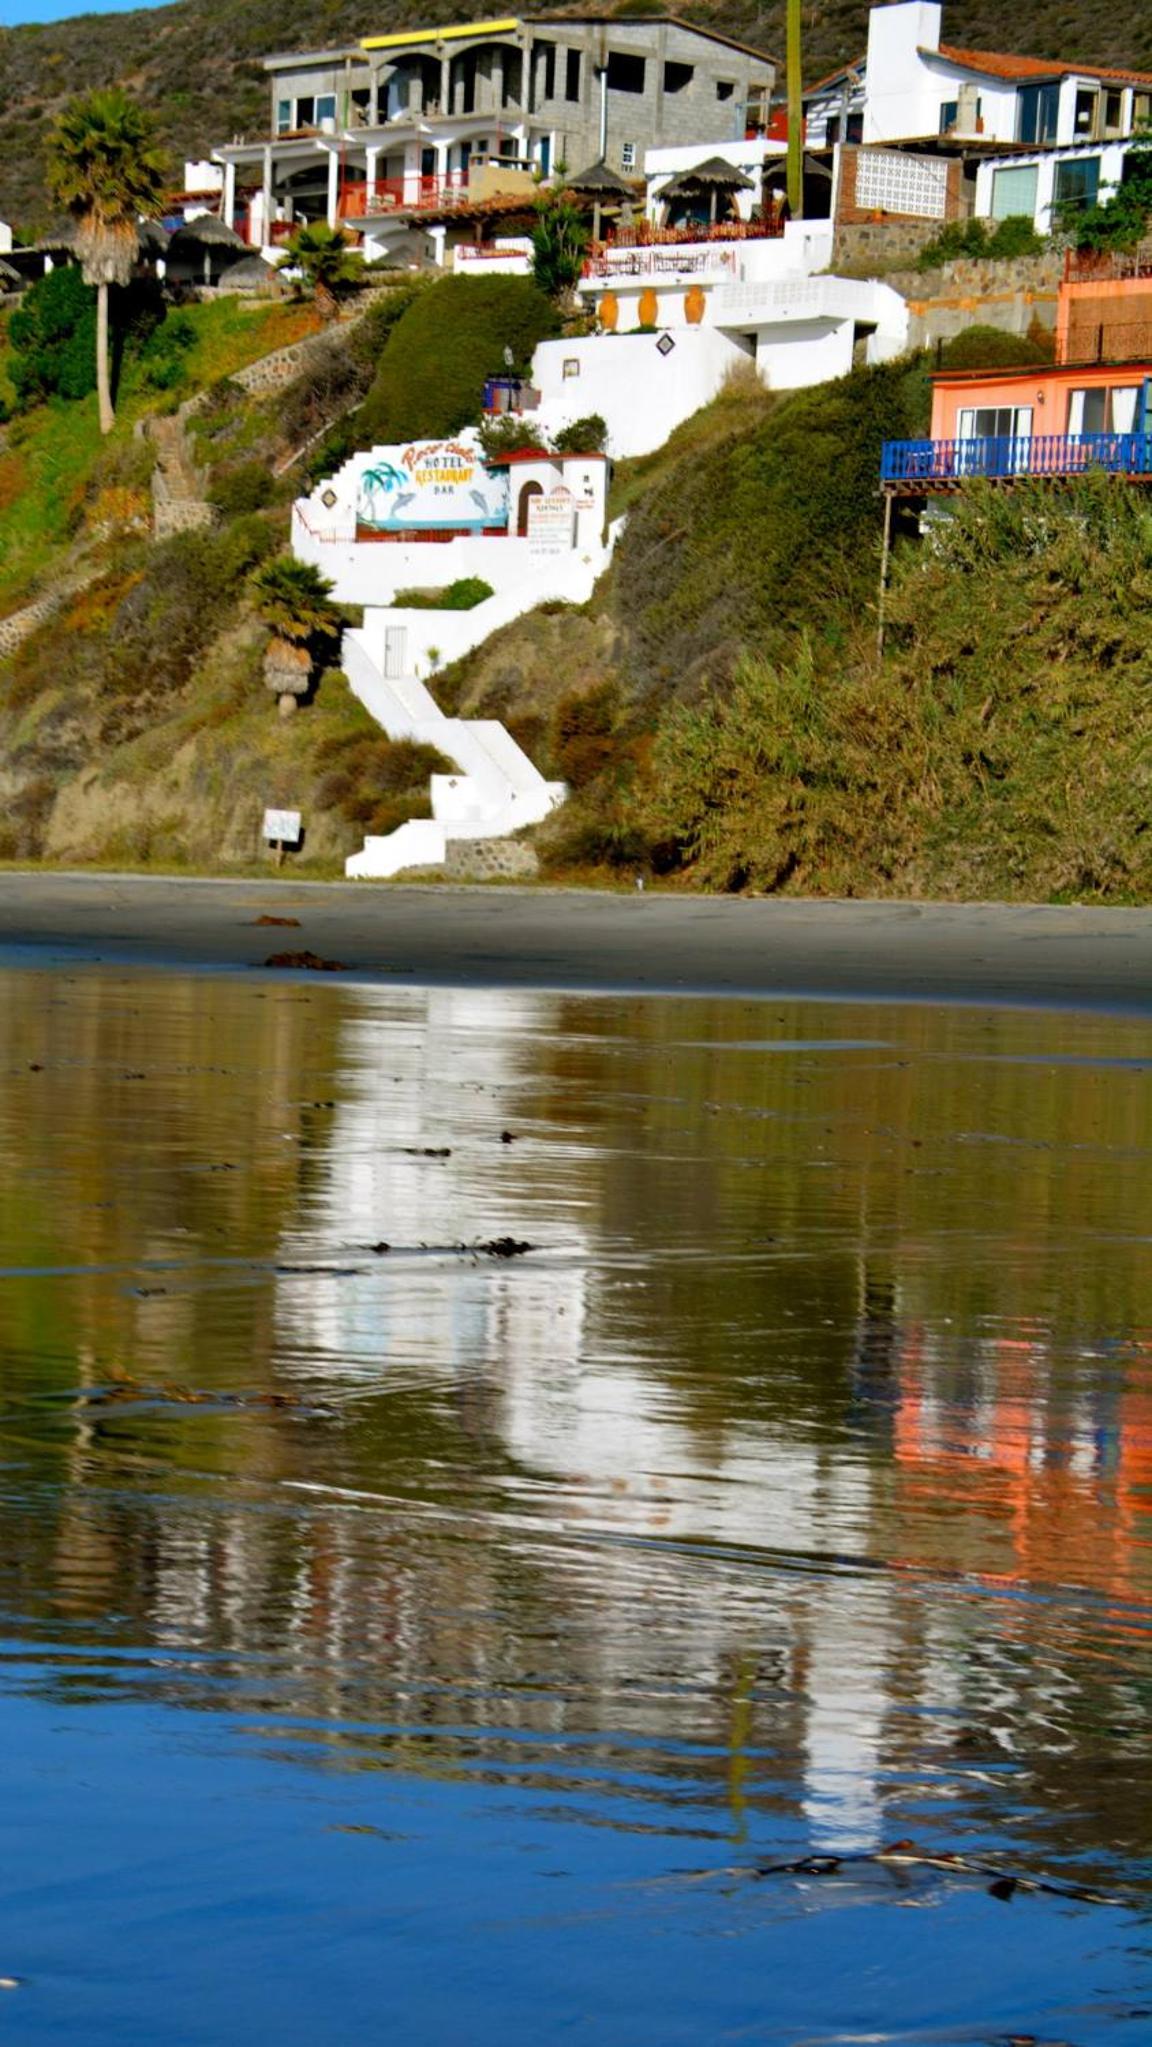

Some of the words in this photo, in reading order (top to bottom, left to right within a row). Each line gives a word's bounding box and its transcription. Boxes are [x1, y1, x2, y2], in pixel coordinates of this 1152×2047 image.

[425, 457, 463, 468] HOTEL
[415, 468, 474, 486] RESTAURANT
[433, 485, 454, 495] BAR
